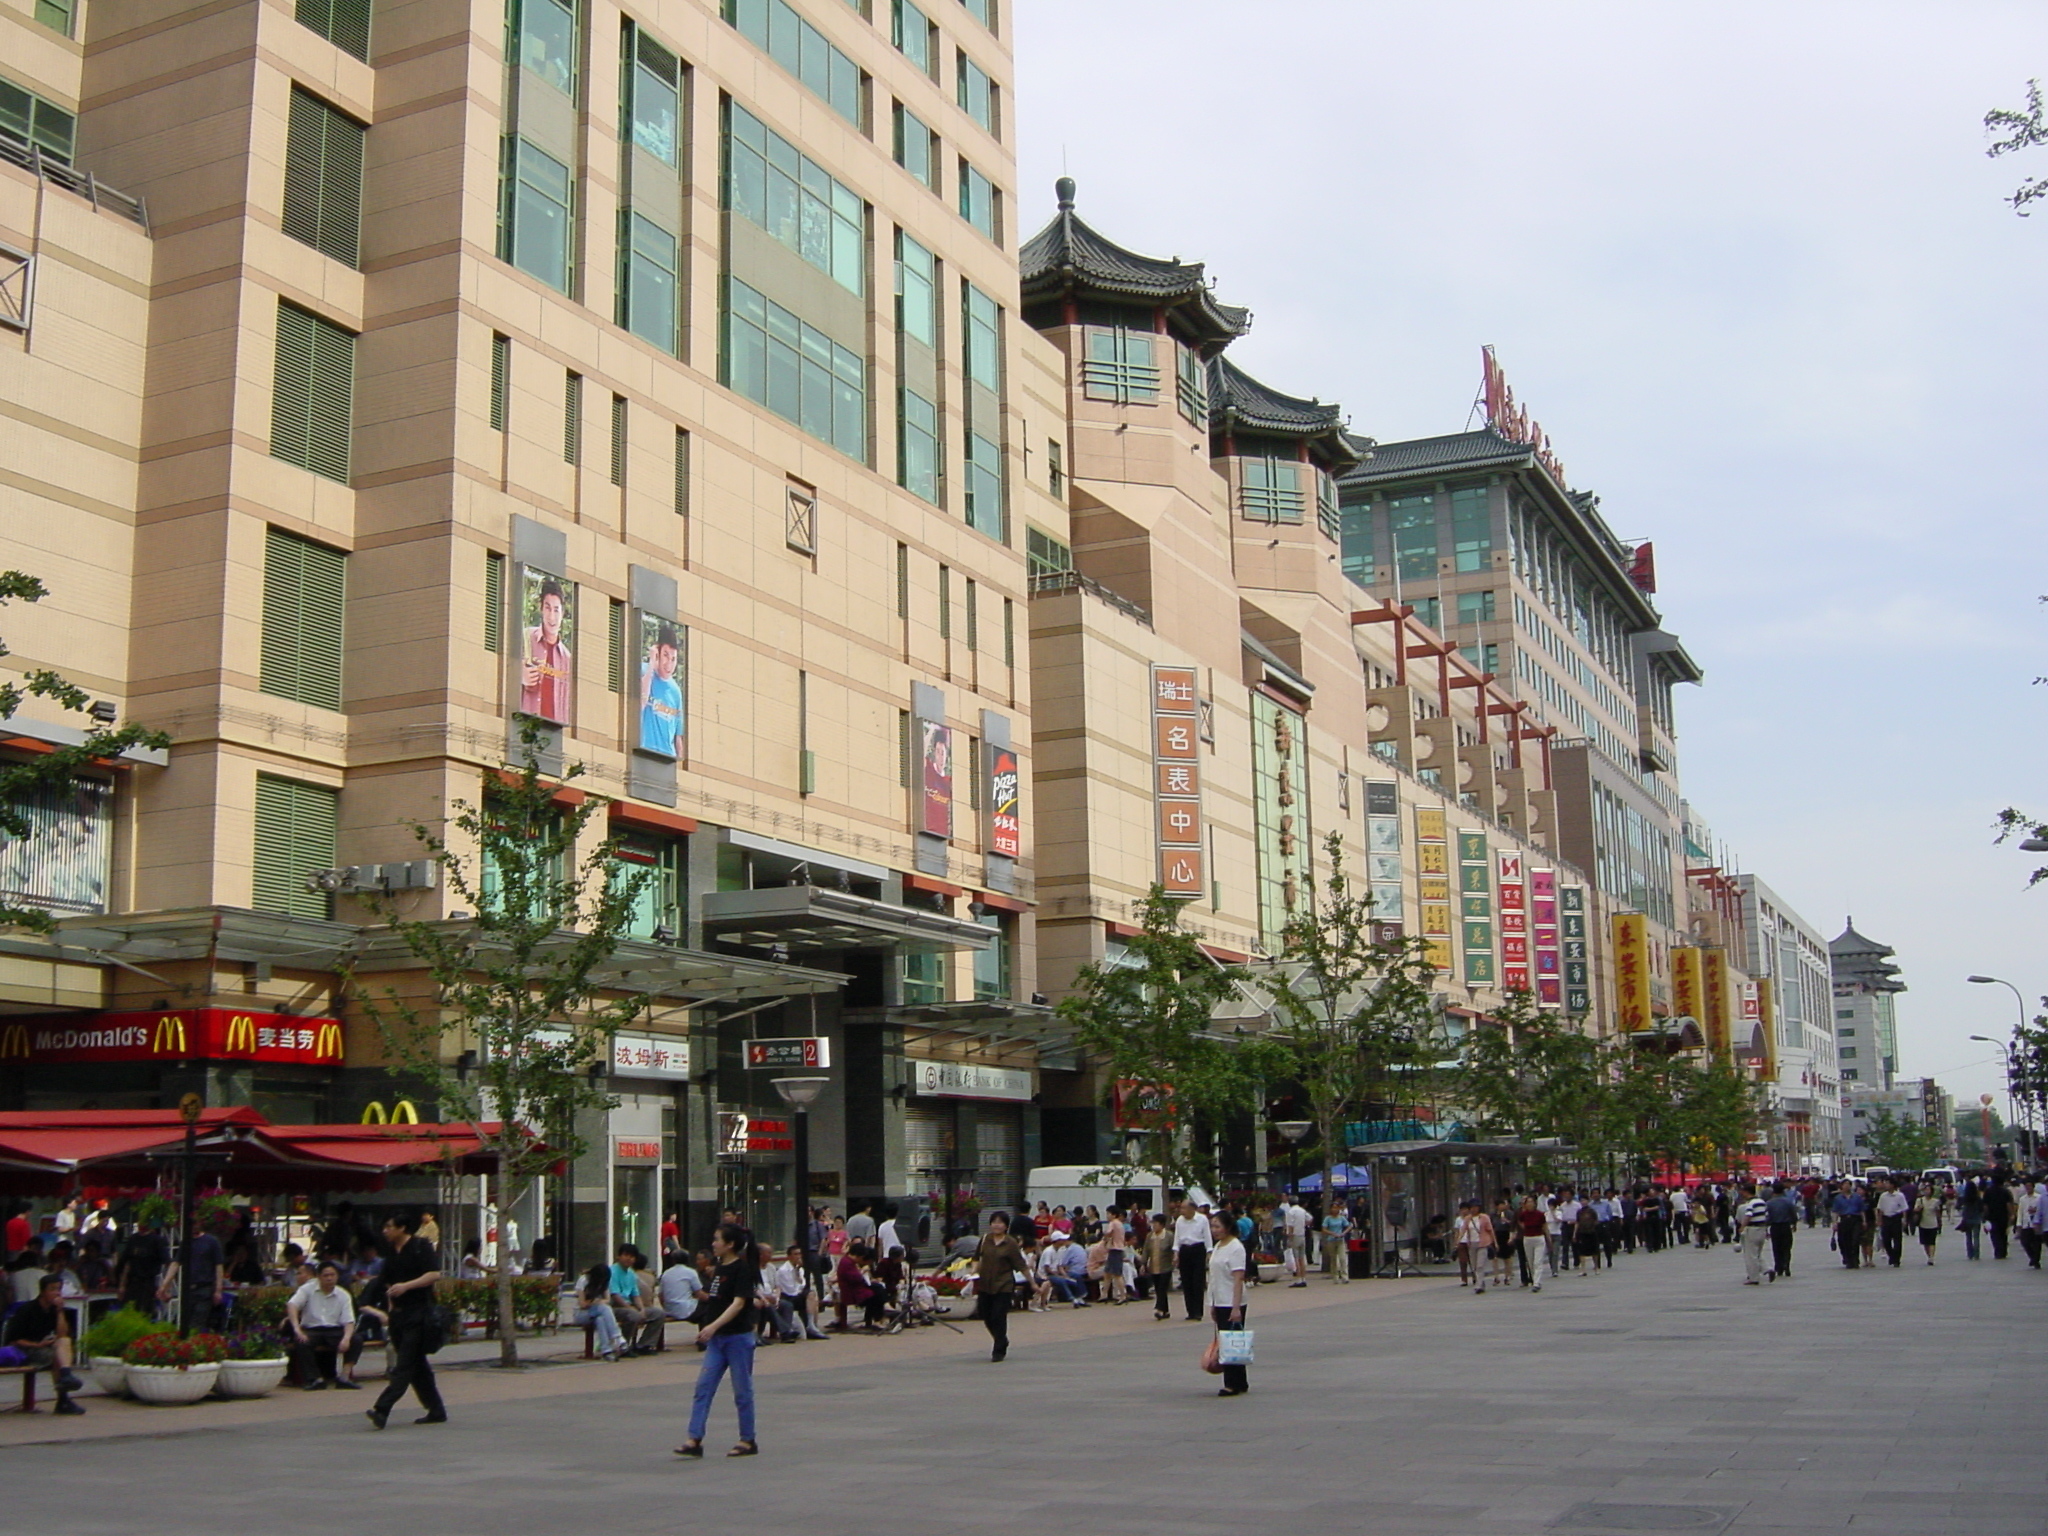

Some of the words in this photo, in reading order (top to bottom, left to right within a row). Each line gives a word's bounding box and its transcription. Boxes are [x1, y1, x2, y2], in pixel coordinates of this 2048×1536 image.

[1158, 680, 1194, 884] 瑞士名表中心
[35, 1025, 148, 1050] McDonald's
[258, 1026, 315, 1050] 麦当劳
[616, 1045, 670, 1069] 波姆斯
[806, 1044, 816, 1061] 2
